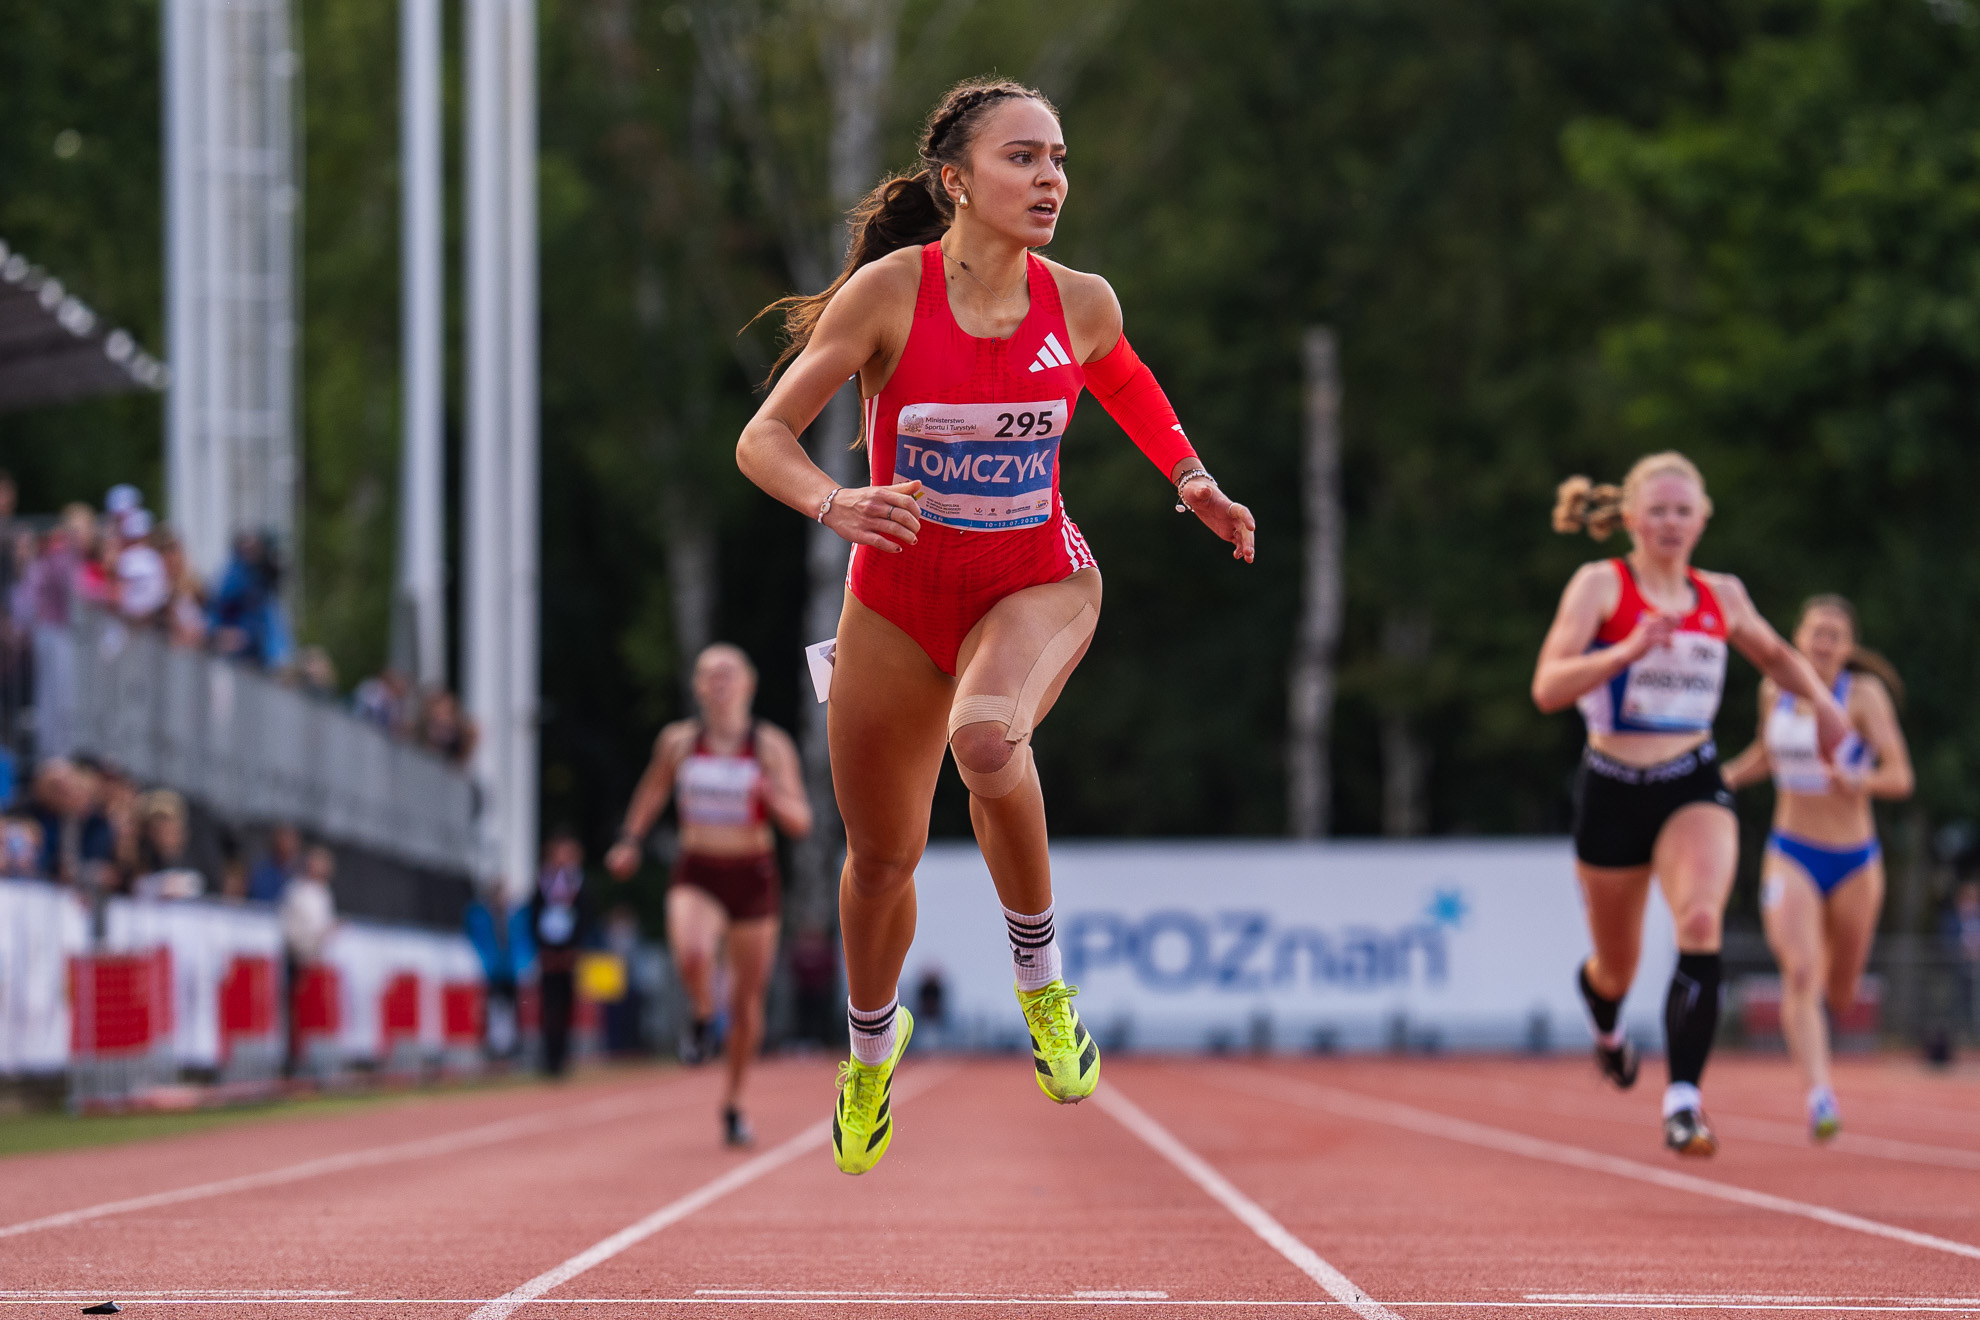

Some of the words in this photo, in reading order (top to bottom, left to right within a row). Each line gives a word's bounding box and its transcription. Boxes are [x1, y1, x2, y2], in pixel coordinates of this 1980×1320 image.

[925, 417, 965, 425] Ministerstwo
[925, 423, 945, 431] Sportu
[994, 410, 1053, 438] 295
[903, 444, 1051, 483] TOMCZYK
[985, 516, 1039, 528] 10-13.07.2025
